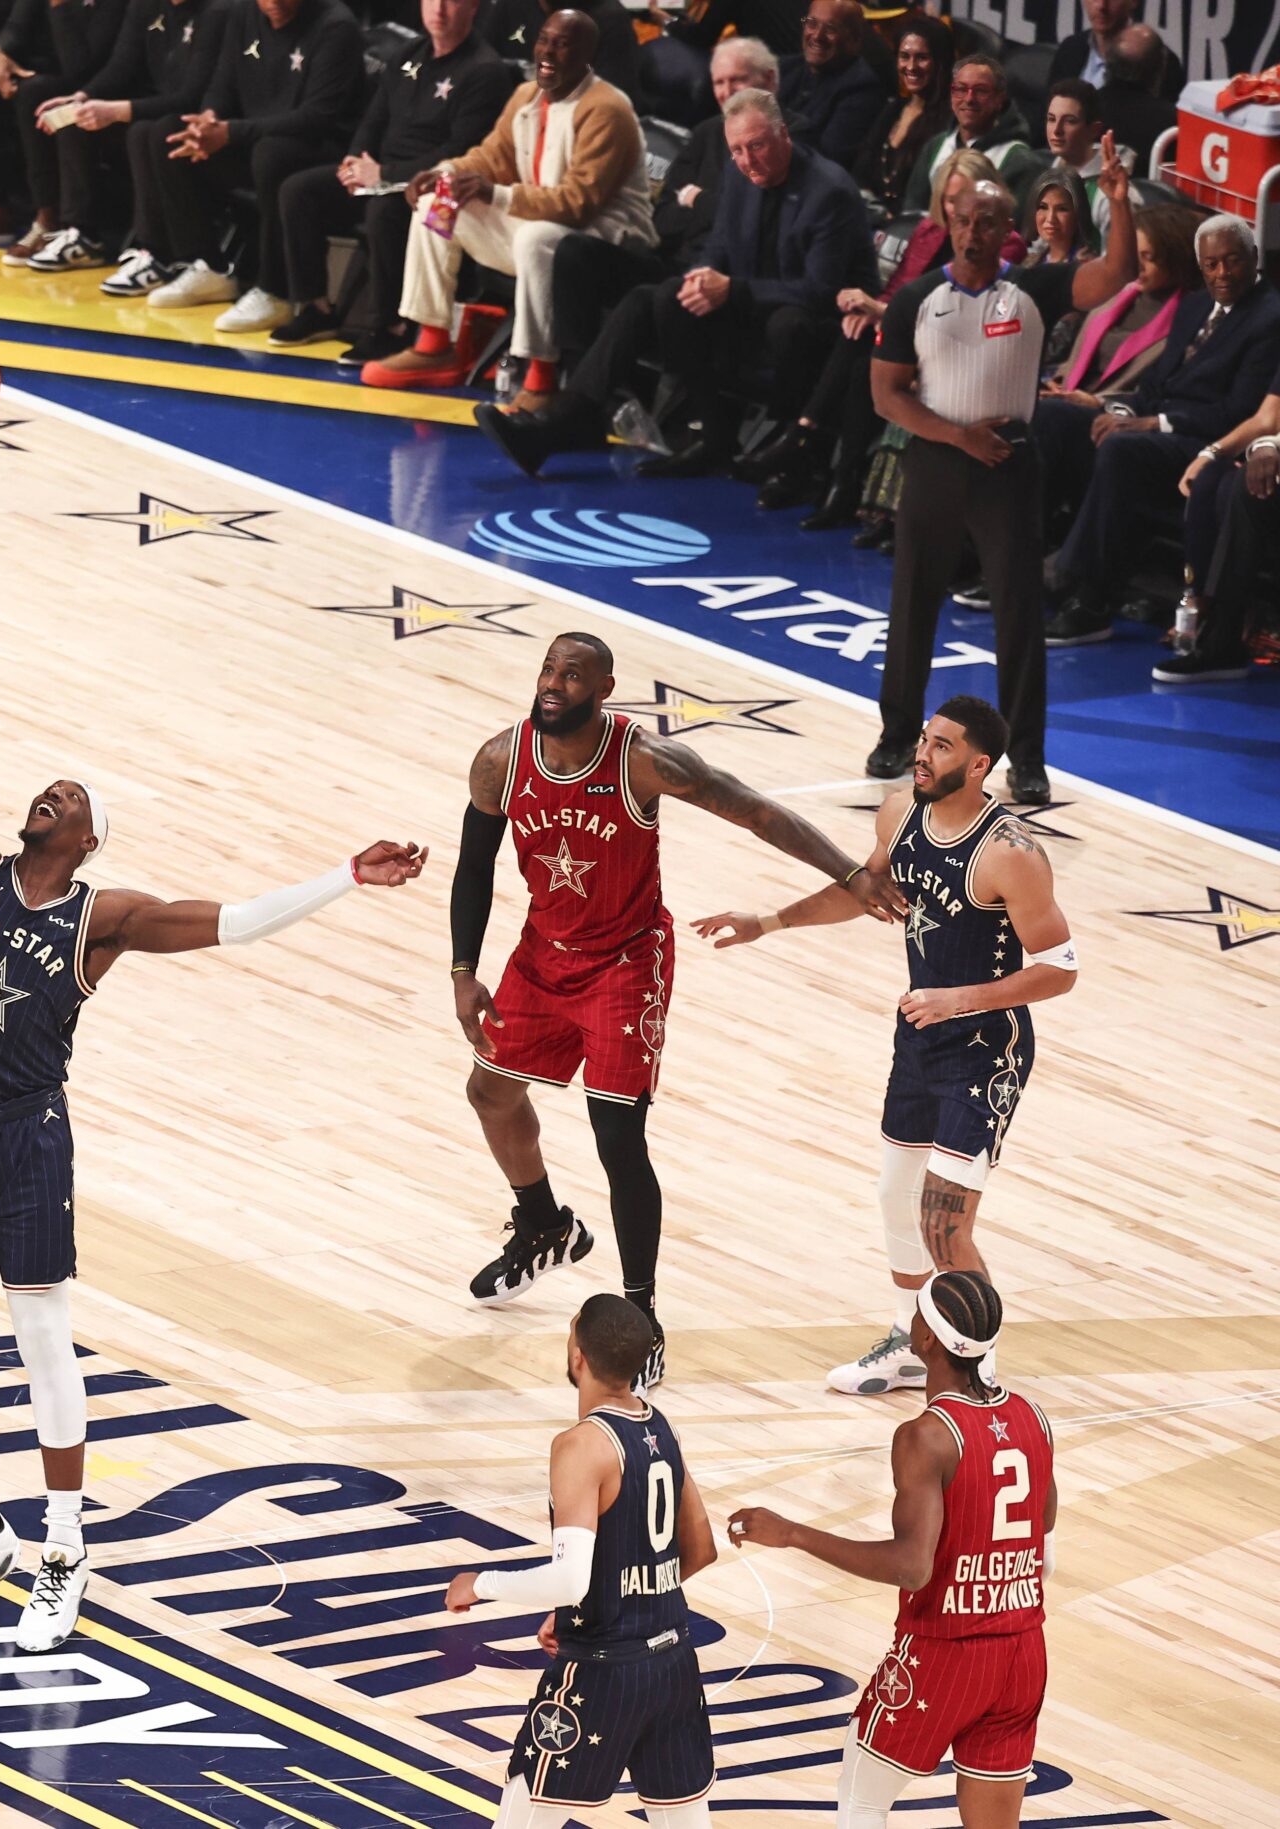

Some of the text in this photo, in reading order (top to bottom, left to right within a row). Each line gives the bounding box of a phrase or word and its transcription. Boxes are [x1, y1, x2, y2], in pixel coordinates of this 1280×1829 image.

[1201, 132, 1229, 183] G
[514, 808, 618, 842] ALL-STAR
[648, 1460, 675, 1553] 0
[992, 1448, 1032, 1541] 2
[955, 1547, 1043, 1583] GILGEOUS-
